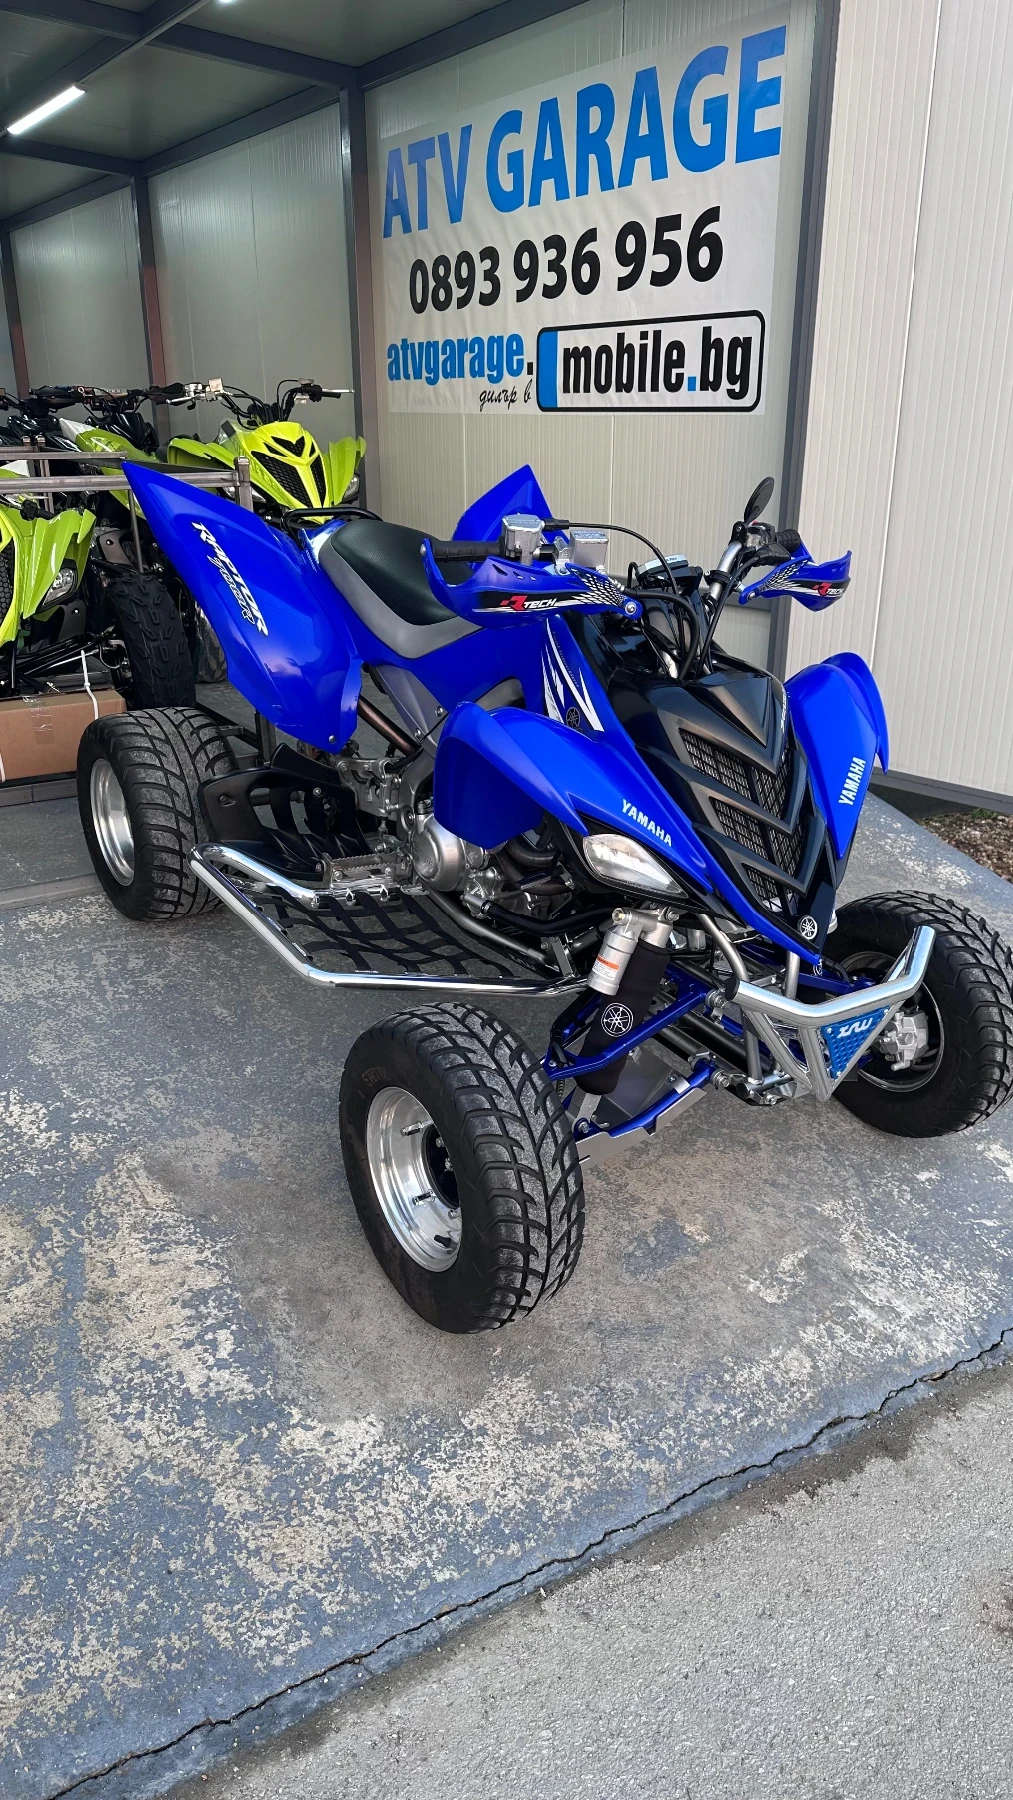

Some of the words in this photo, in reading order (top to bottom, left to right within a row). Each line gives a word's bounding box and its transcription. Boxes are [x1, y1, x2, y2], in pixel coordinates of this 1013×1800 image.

[382, 124, 473, 238] ATV
[485, 25, 787, 213] GARAGE
[409, 246, 501, 314] 0893
[513, 228, 601, 303] 936
[615, 206, 724, 291] 956
[479, 386, 518, 412] дилър
[562, 326, 752, 399] mobile.bg
[191, 522, 269, 637] RAPTOR
[838, 757, 867, 805] YAMAHA
[622, 798, 672, 848] YAMAHA
